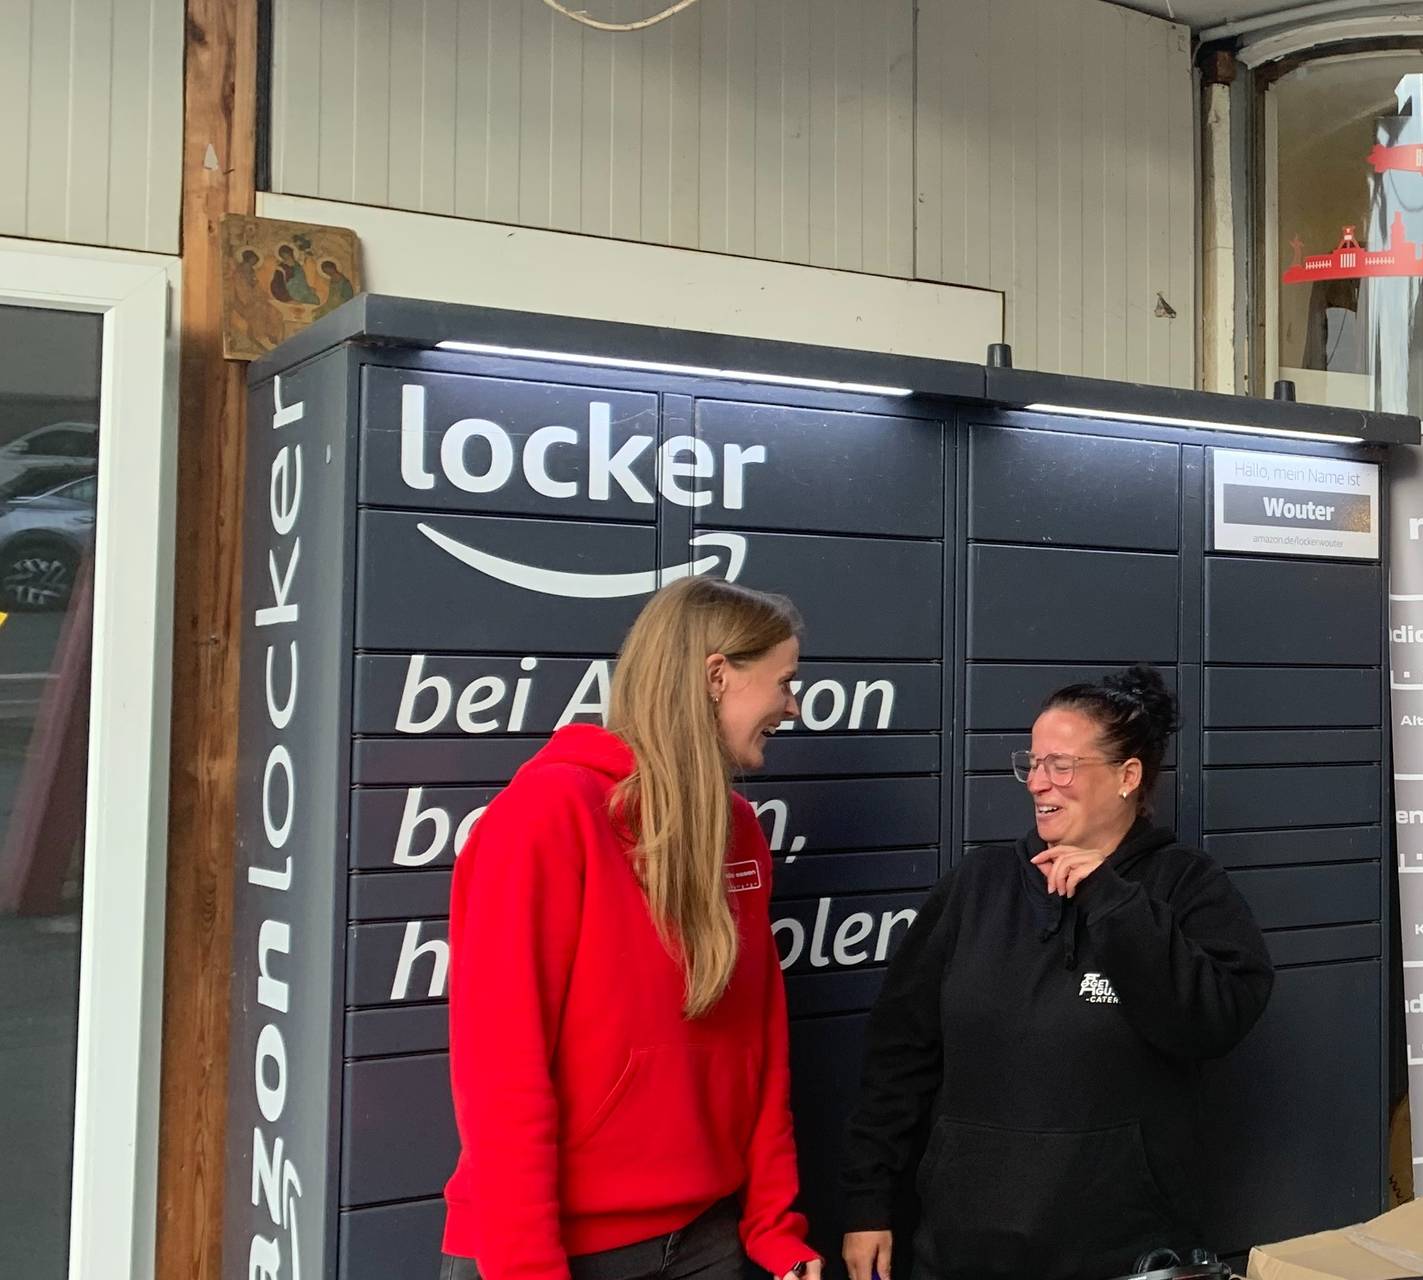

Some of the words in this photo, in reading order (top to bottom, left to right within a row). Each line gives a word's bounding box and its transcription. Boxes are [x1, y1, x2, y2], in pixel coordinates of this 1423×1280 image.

[400, 384, 766, 510] locker
[1234, 462, 1270, 480] Hallo,
[1273, 467, 1305, 481] mein
[1308, 469, 1345, 485] Name
[1347, 473, 1361, 487] ist
[1262, 496, 1335, 521] Wouter
[395, 655, 538, 733] bei
[772, 898, 920, 968] olen
